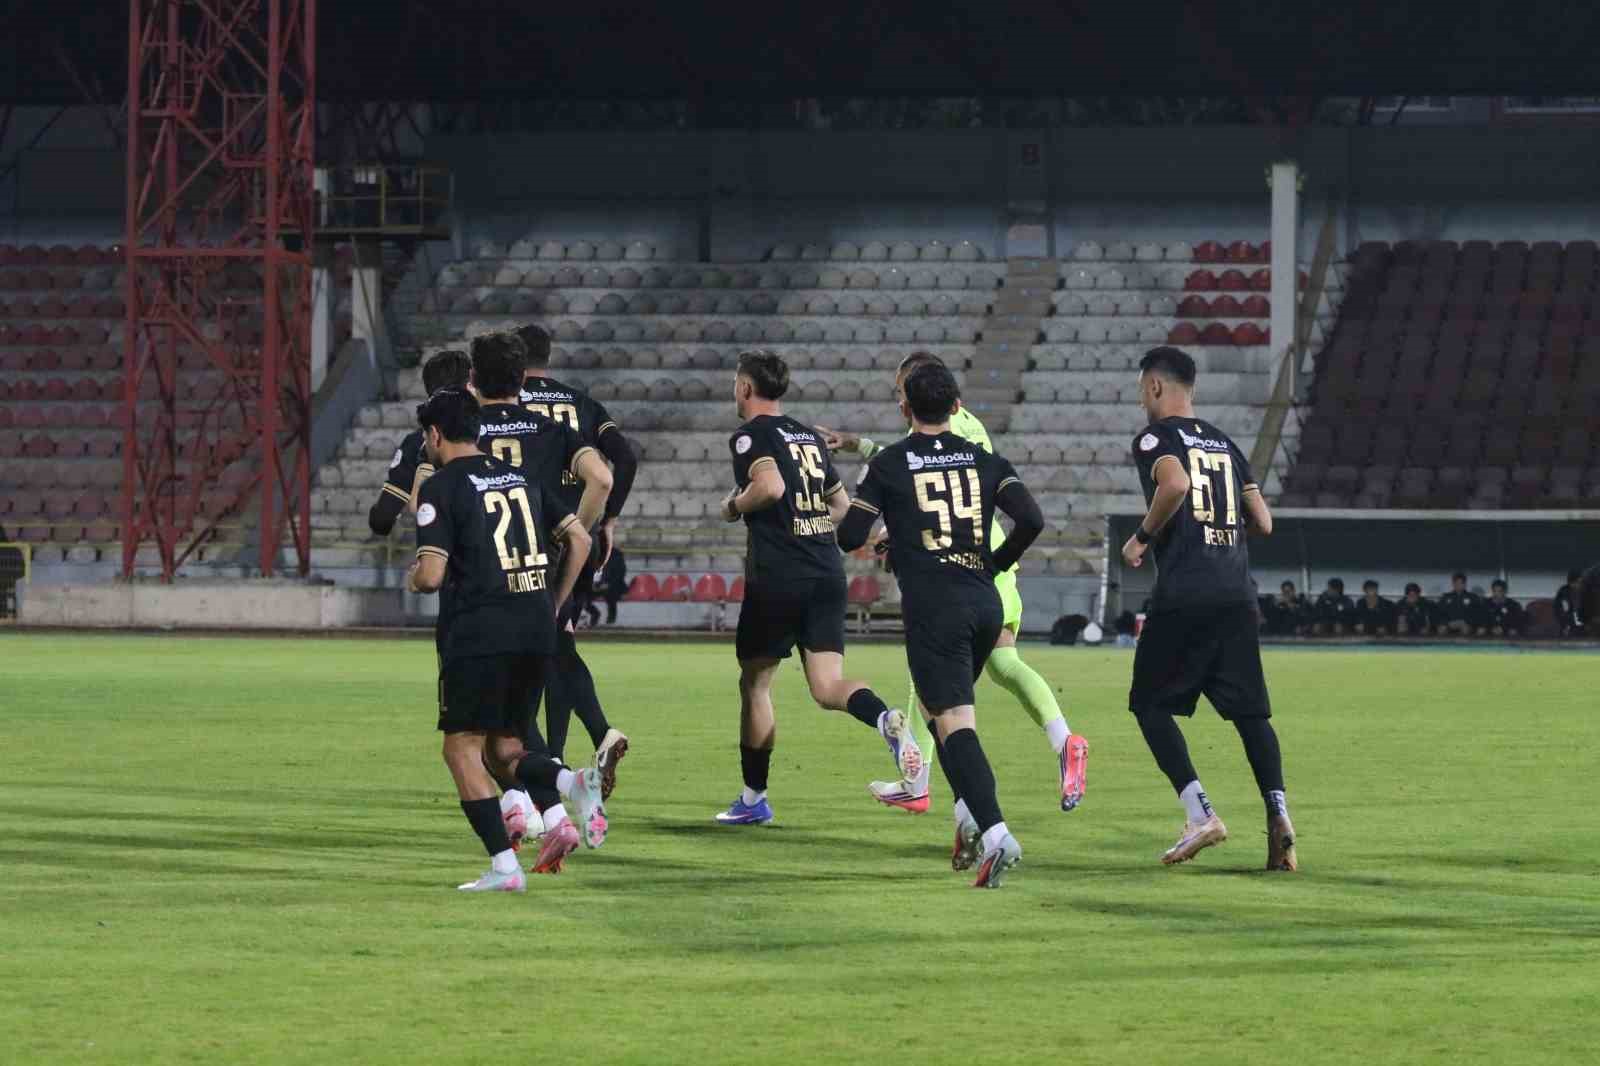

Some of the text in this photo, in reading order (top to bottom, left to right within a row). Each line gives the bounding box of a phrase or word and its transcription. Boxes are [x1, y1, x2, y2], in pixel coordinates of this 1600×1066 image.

[913, 468, 983, 551] 54
[1188, 448, 1236, 525] 67
[484, 487, 548, 570] 21
